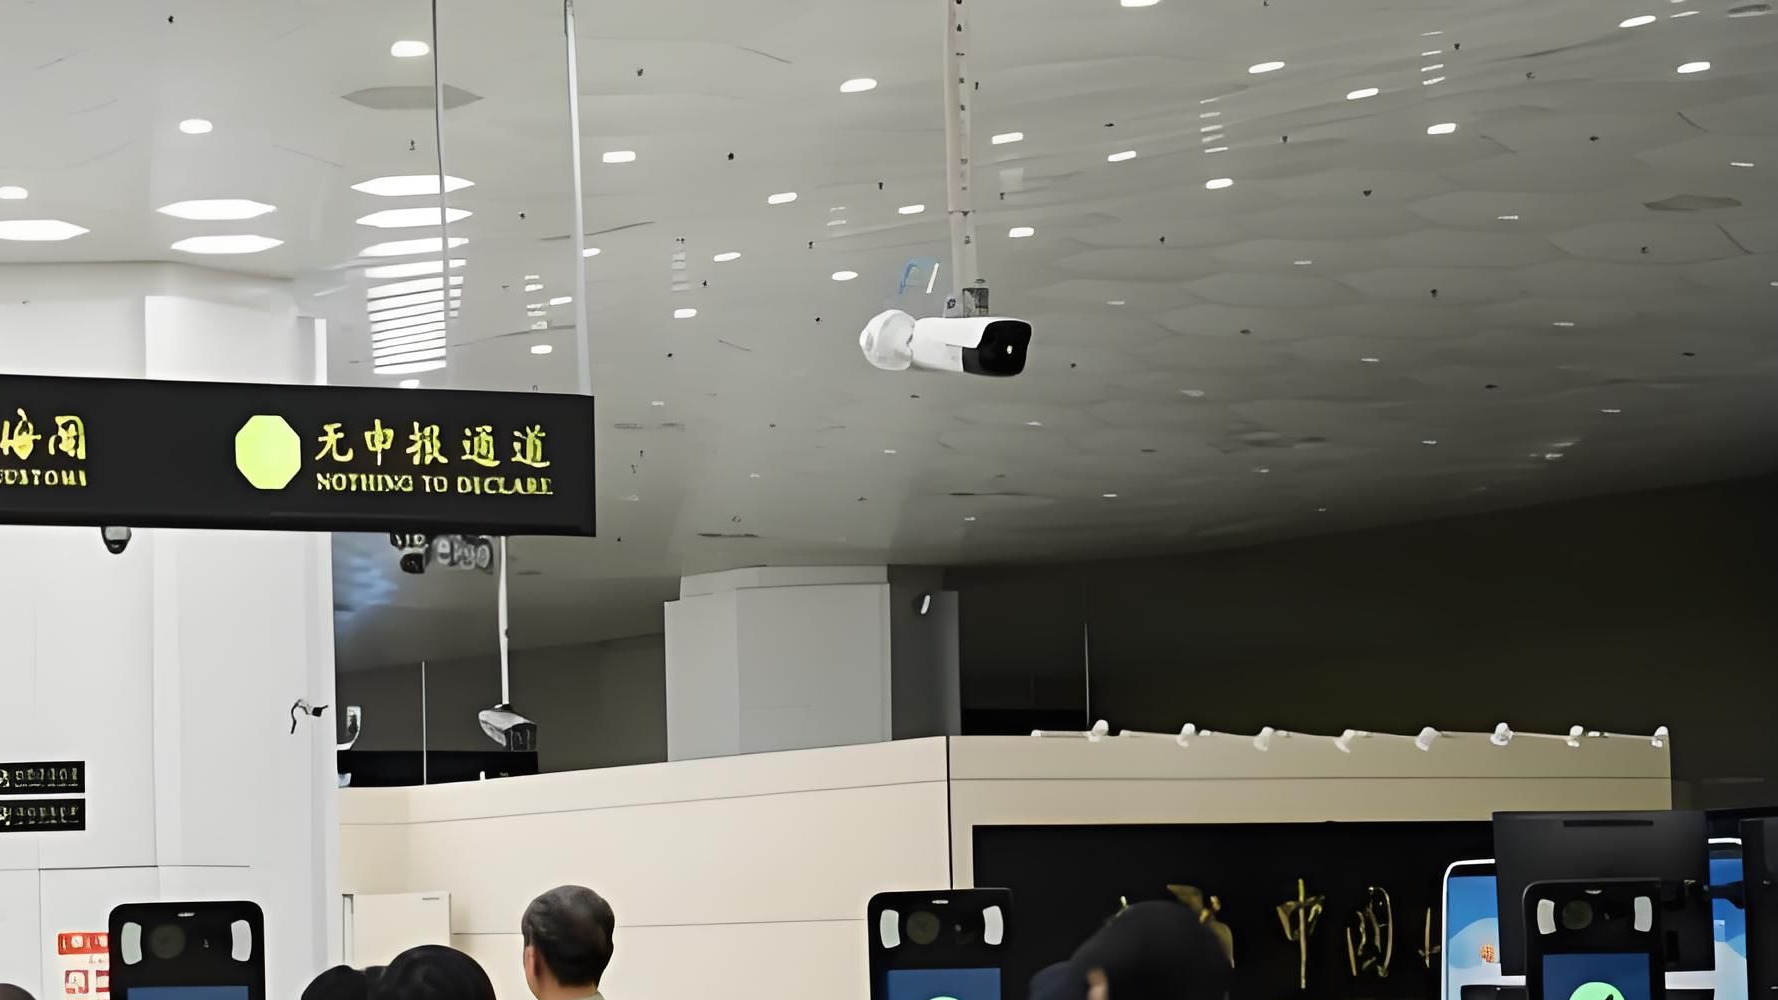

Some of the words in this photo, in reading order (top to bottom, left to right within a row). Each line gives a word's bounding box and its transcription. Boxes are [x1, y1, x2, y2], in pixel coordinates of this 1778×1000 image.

[314, 418, 551, 468] 无申报通道
[316, 472, 414, 492] NOTHING
[421, 474, 448, 493] TO
